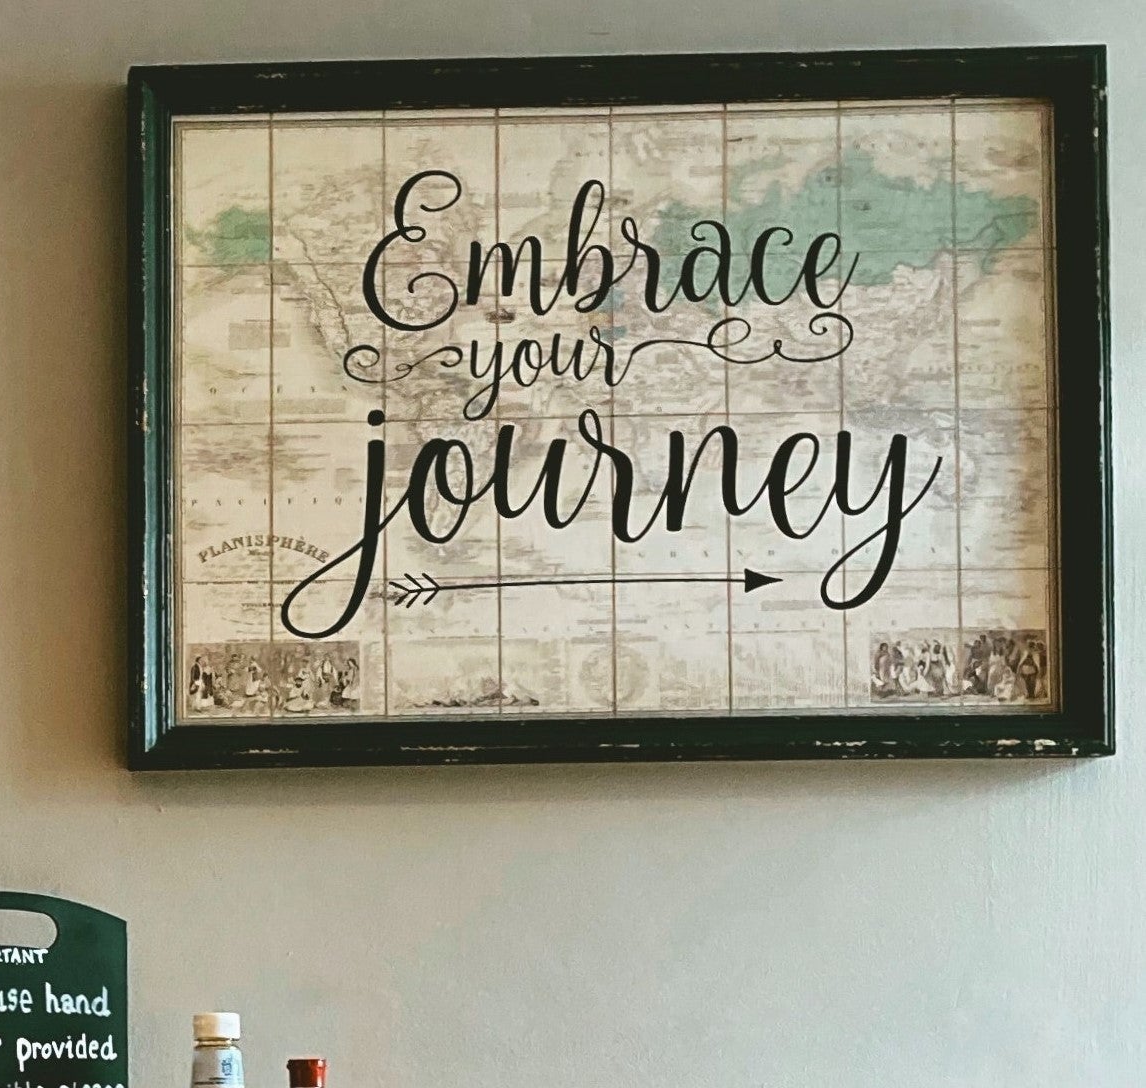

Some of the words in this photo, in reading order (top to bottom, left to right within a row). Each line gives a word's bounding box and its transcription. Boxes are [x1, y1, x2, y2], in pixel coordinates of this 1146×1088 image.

[362, 170, 861, 332] Embrace
[281, 408, 943, 639] journey
[198, 535, 330, 563] PLANISPHÈRE
[44, 981, 112, 1018] hand
[16, 1032, 118, 1072] provided
